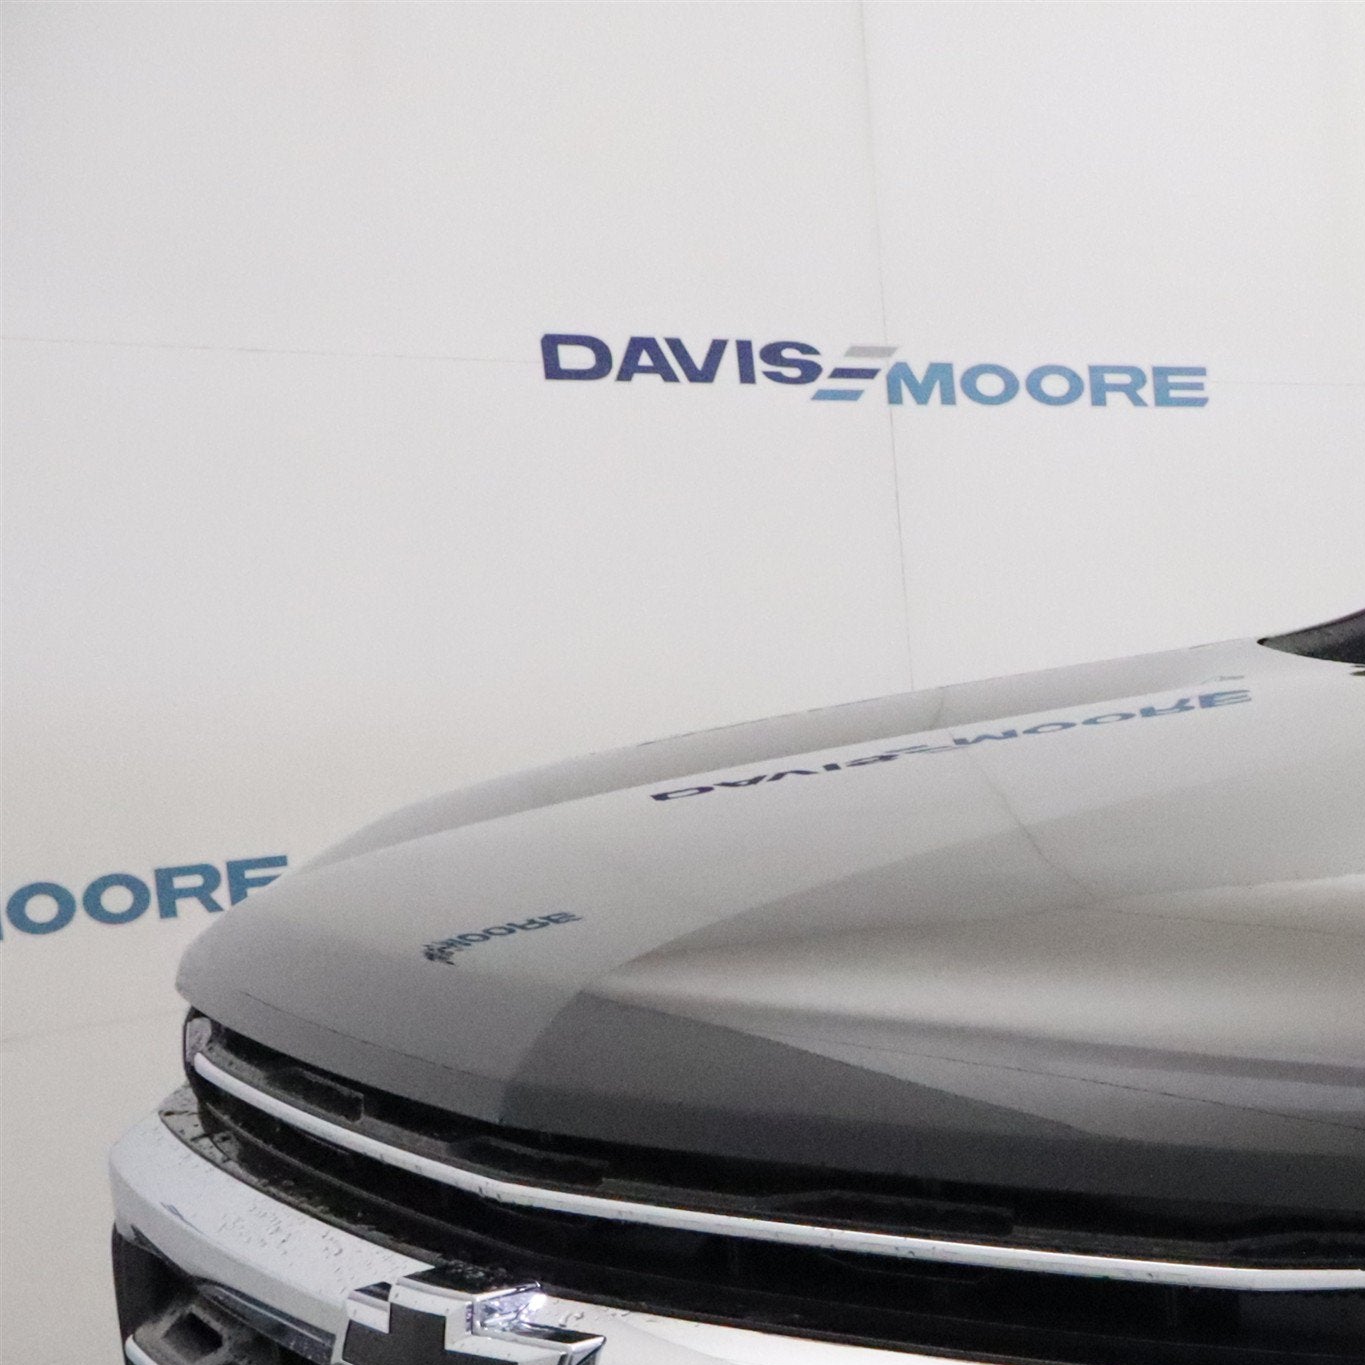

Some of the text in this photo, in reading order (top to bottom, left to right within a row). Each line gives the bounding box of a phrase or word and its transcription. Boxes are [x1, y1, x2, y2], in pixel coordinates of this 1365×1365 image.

[540, 333, 1210, 408] DAVIS MOORE
[0, 855, 289, 941] OORE
